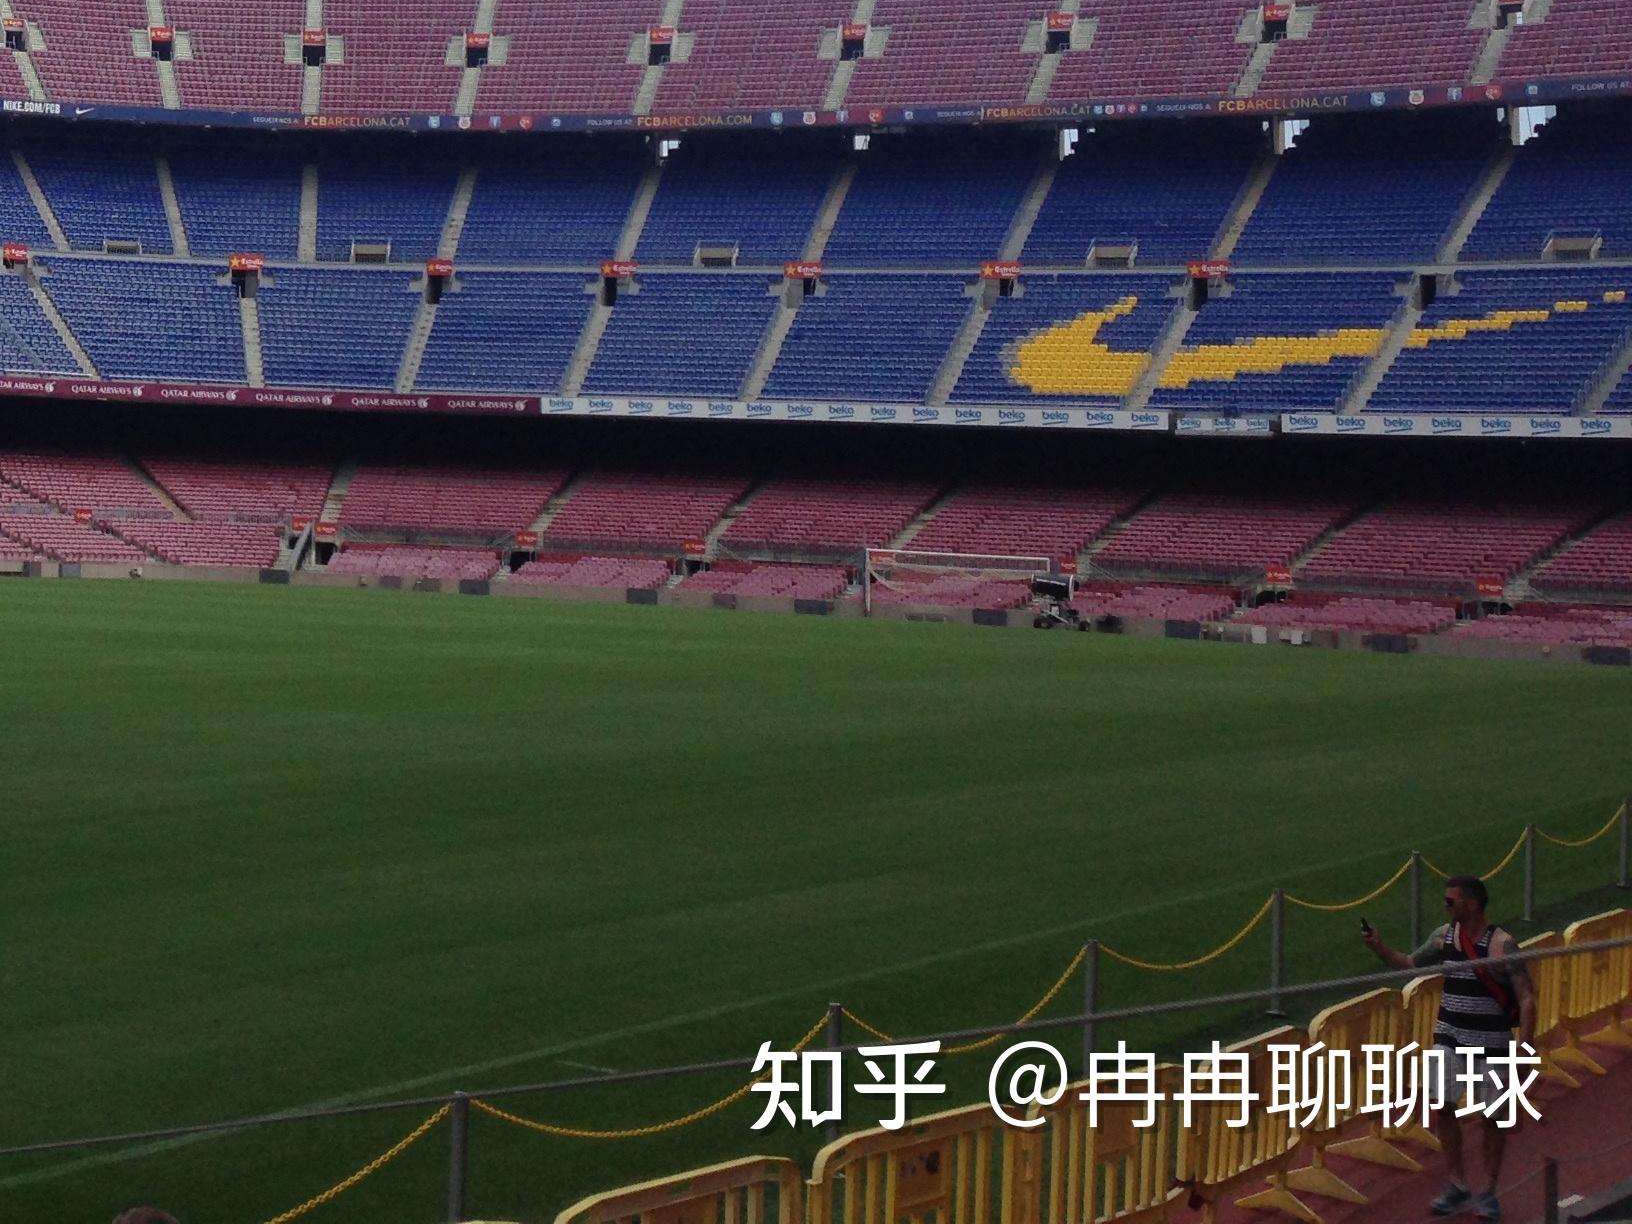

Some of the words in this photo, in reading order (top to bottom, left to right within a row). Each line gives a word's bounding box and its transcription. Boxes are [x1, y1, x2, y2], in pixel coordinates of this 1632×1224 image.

[3, 100, 61, 114] NIKE.COM/FCB
[1218, 96, 1348, 112] FCBARCELONA.CAT
[986, 105, 1091, 118] FCBARCELONA.CAT
[304, 116, 411, 127] FCBARCELONA.CAT
[637, 115, 753, 127] FCBARCELONA.COM
[71, 384, 97, 394] QATAR
[98, 386, 132, 395] AIRWAYS
[161, 388, 188, 398] QATAR
[189, 390, 225, 400] AIRWAYS
[255, 393, 284, 403] QATAR
[285, 394, 320, 403] AIRWAYS
[351, 397, 379, 407] QATAR
[381, 398, 417, 407] AIRWAYS
[448, 399, 476, 409] QATAR
[477, 400, 514, 410] AIRWAYS
[549, 399, 574, 409] beko
[588, 399, 613, 409] beko
[628, 400, 653, 410] beko
[668, 401, 693, 411] beko
[708, 402, 733, 412] beko
[746, 403, 772, 413] beko
[787, 404, 813, 414] beko
[828, 405, 854, 416] beko
[870, 406, 896, 417] beko
[912, 407, 939, 417] beko
[955, 408, 982, 418] beko
[998, 409, 1026, 420] beko
[1042, 410, 1069, 421] beko
[1086, 411, 1114, 422] beko
[1131, 412, 1159, 423] beko
[1289, 415, 1318, 426] beko
[1336, 416, 1366, 427] beko
[1383, 417, 1413, 427] beko
[1431, 418, 1462, 428] beko
[1481, 418, 1512, 429] beko
[1530, 419, 1561, 429] beko
[1580, 419, 1612, 429] beko
